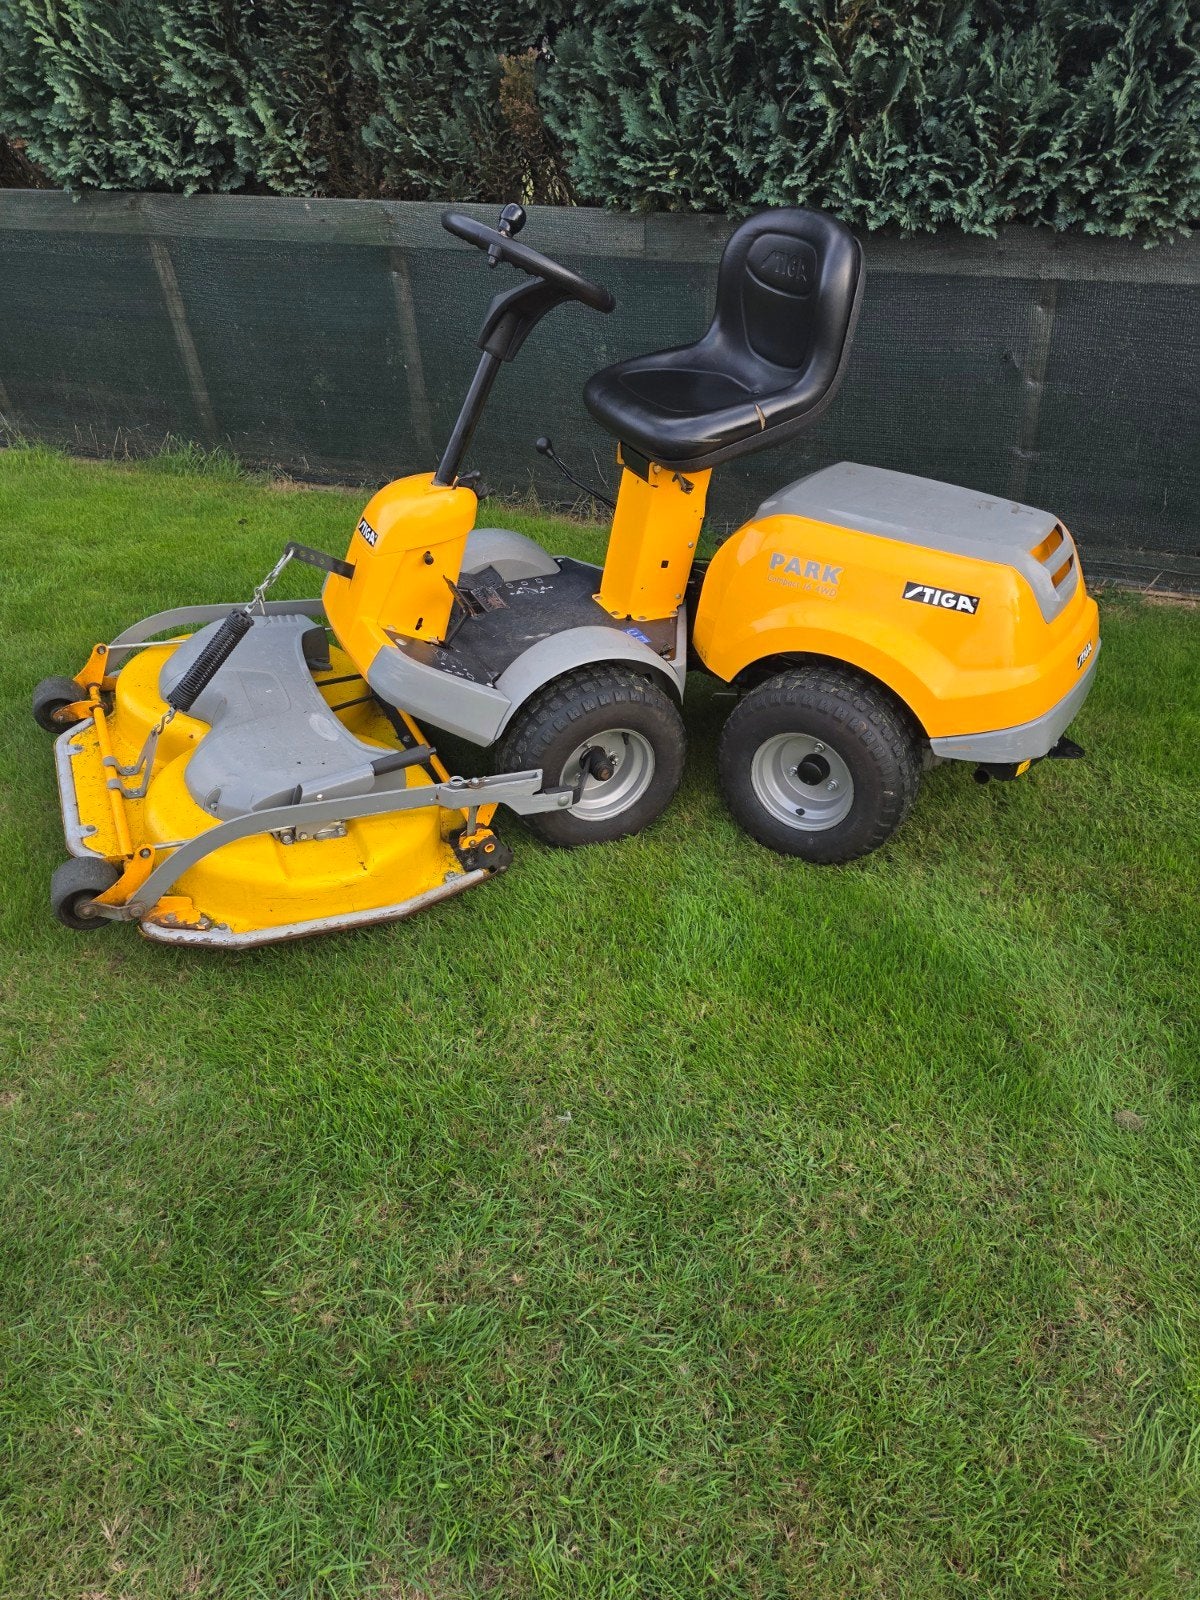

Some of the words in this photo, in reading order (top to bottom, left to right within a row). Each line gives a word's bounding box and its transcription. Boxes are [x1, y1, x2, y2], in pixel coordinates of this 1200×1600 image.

[760, 250, 807, 282] STIGA
[358, 520, 376, 546] STIGA
[770, 552, 843, 585] PARK
[815, 584, 837, 598] 4WD
[904, 586, 975, 613] STIGA
